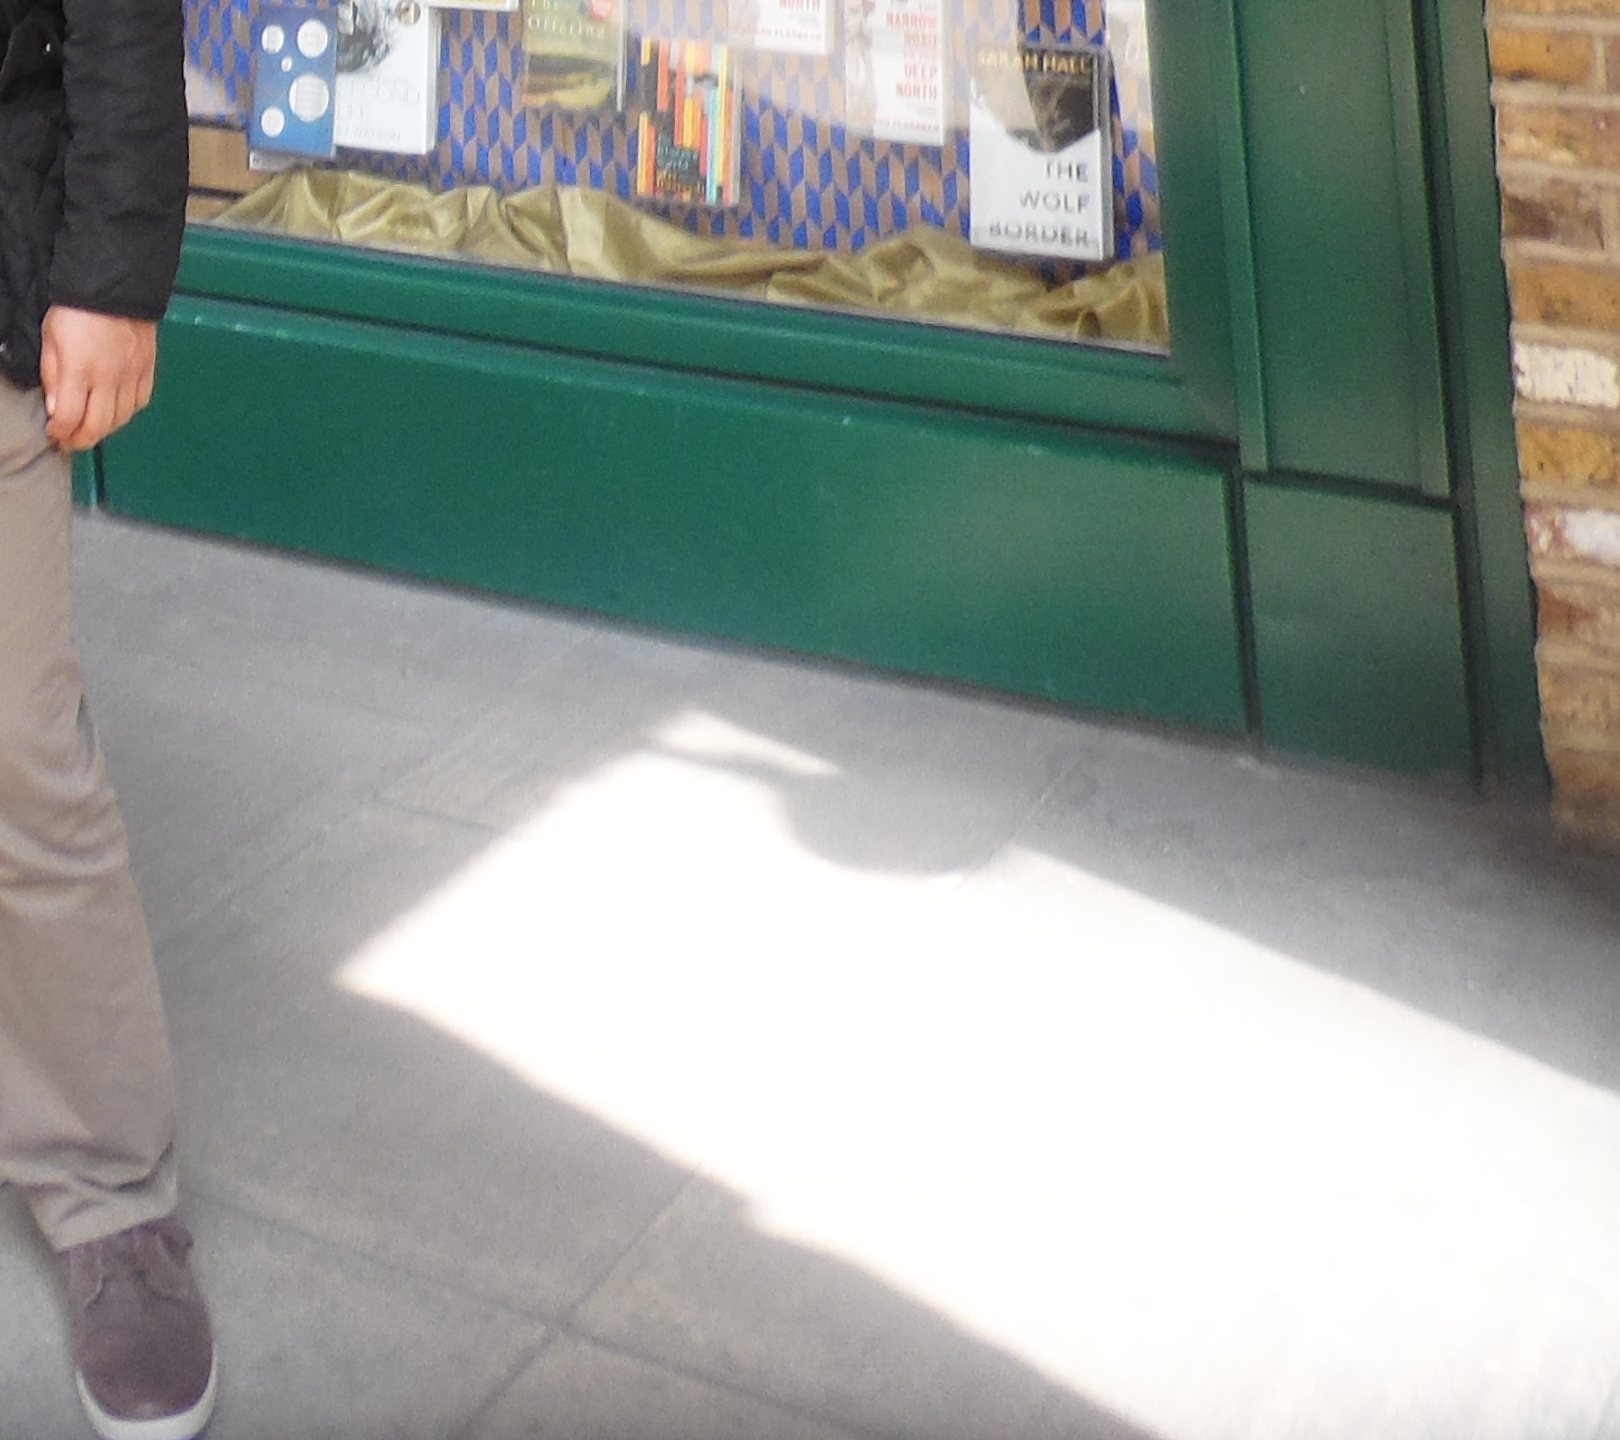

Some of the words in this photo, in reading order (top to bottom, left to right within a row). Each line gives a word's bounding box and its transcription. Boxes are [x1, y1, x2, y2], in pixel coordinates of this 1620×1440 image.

[527, 16, 606, 40] Offering
[1045, 160, 1089, 183] THE
[1019, 190, 1090, 214] WOLF
[988, 222, 1089, 249] BORDER
